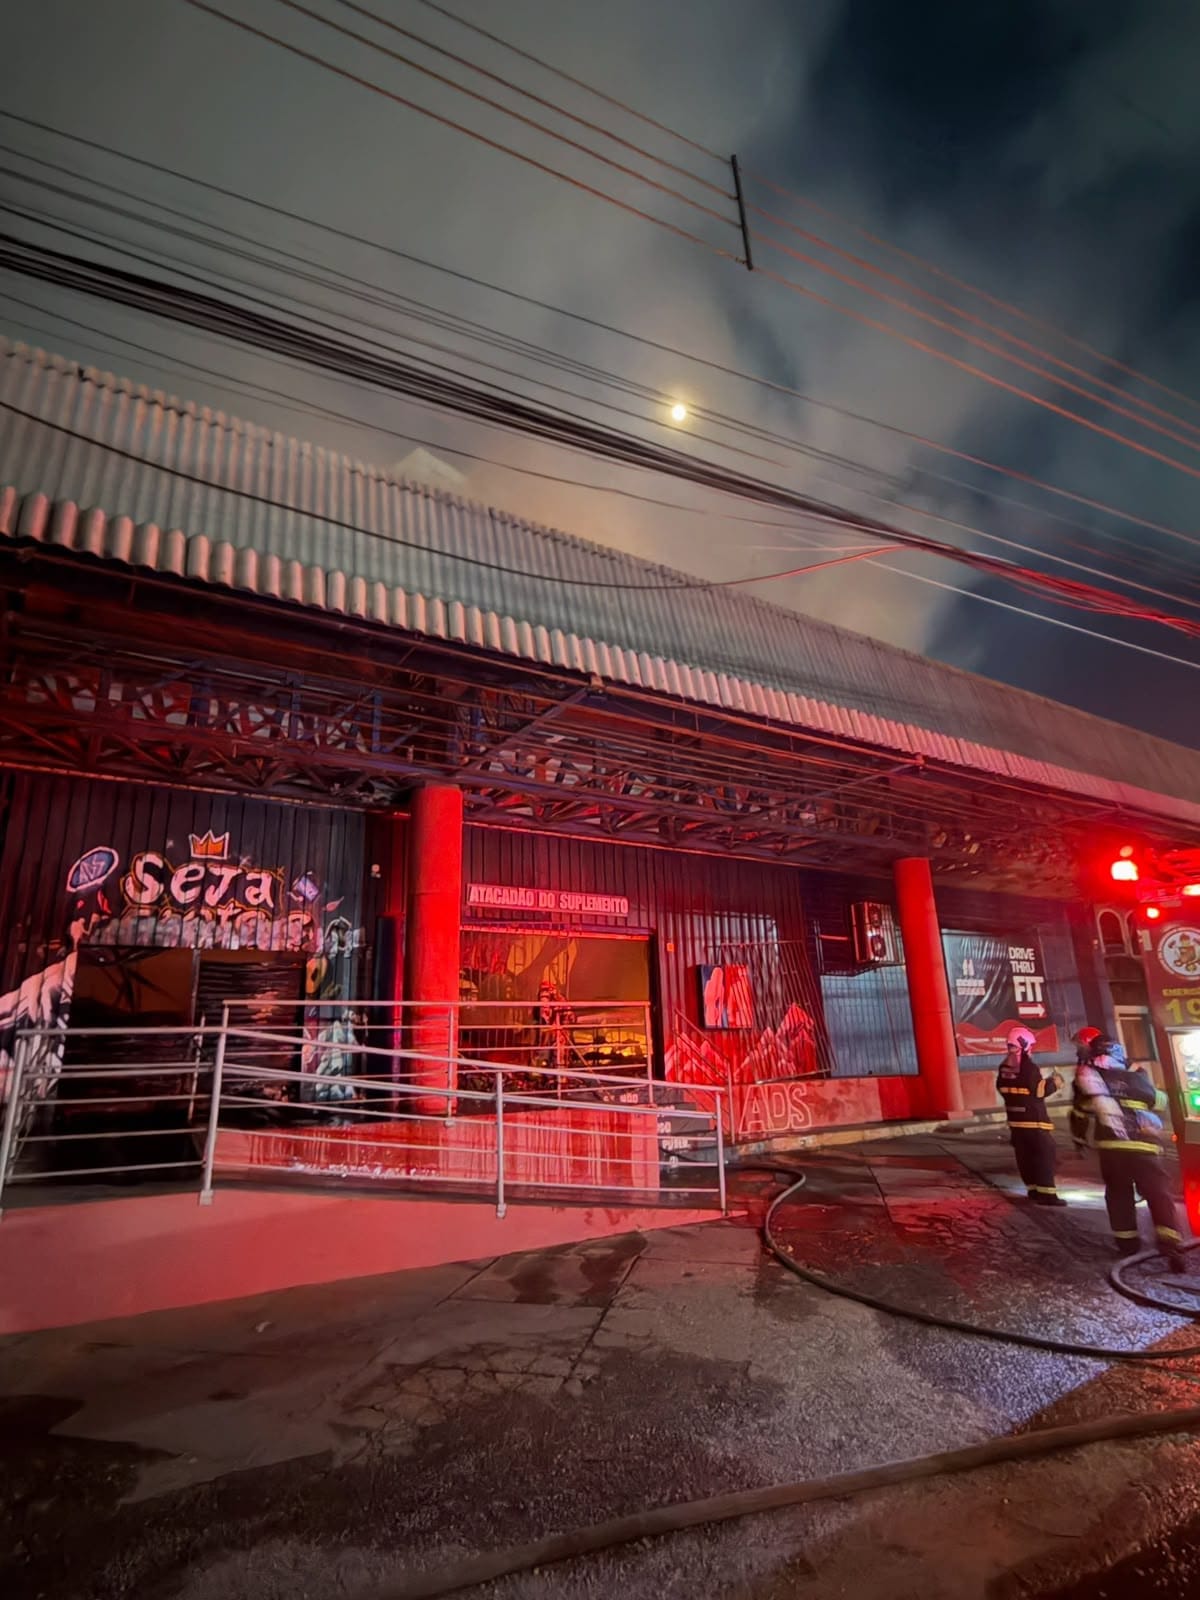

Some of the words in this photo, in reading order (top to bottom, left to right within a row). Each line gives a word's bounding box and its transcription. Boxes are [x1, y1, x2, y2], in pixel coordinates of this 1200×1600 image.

[469, 885, 535, 908] ATACADÃO
[538, 891, 556, 909] DO
[559, 893, 629, 915] SUPLEMENTO
[1008, 946, 1036, 960] DRIVE
[1011, 960, 1036, 974] THRU
[1012, 975, 1045, 1002] FIT
[738, 1082, 812, 1134] ADS
